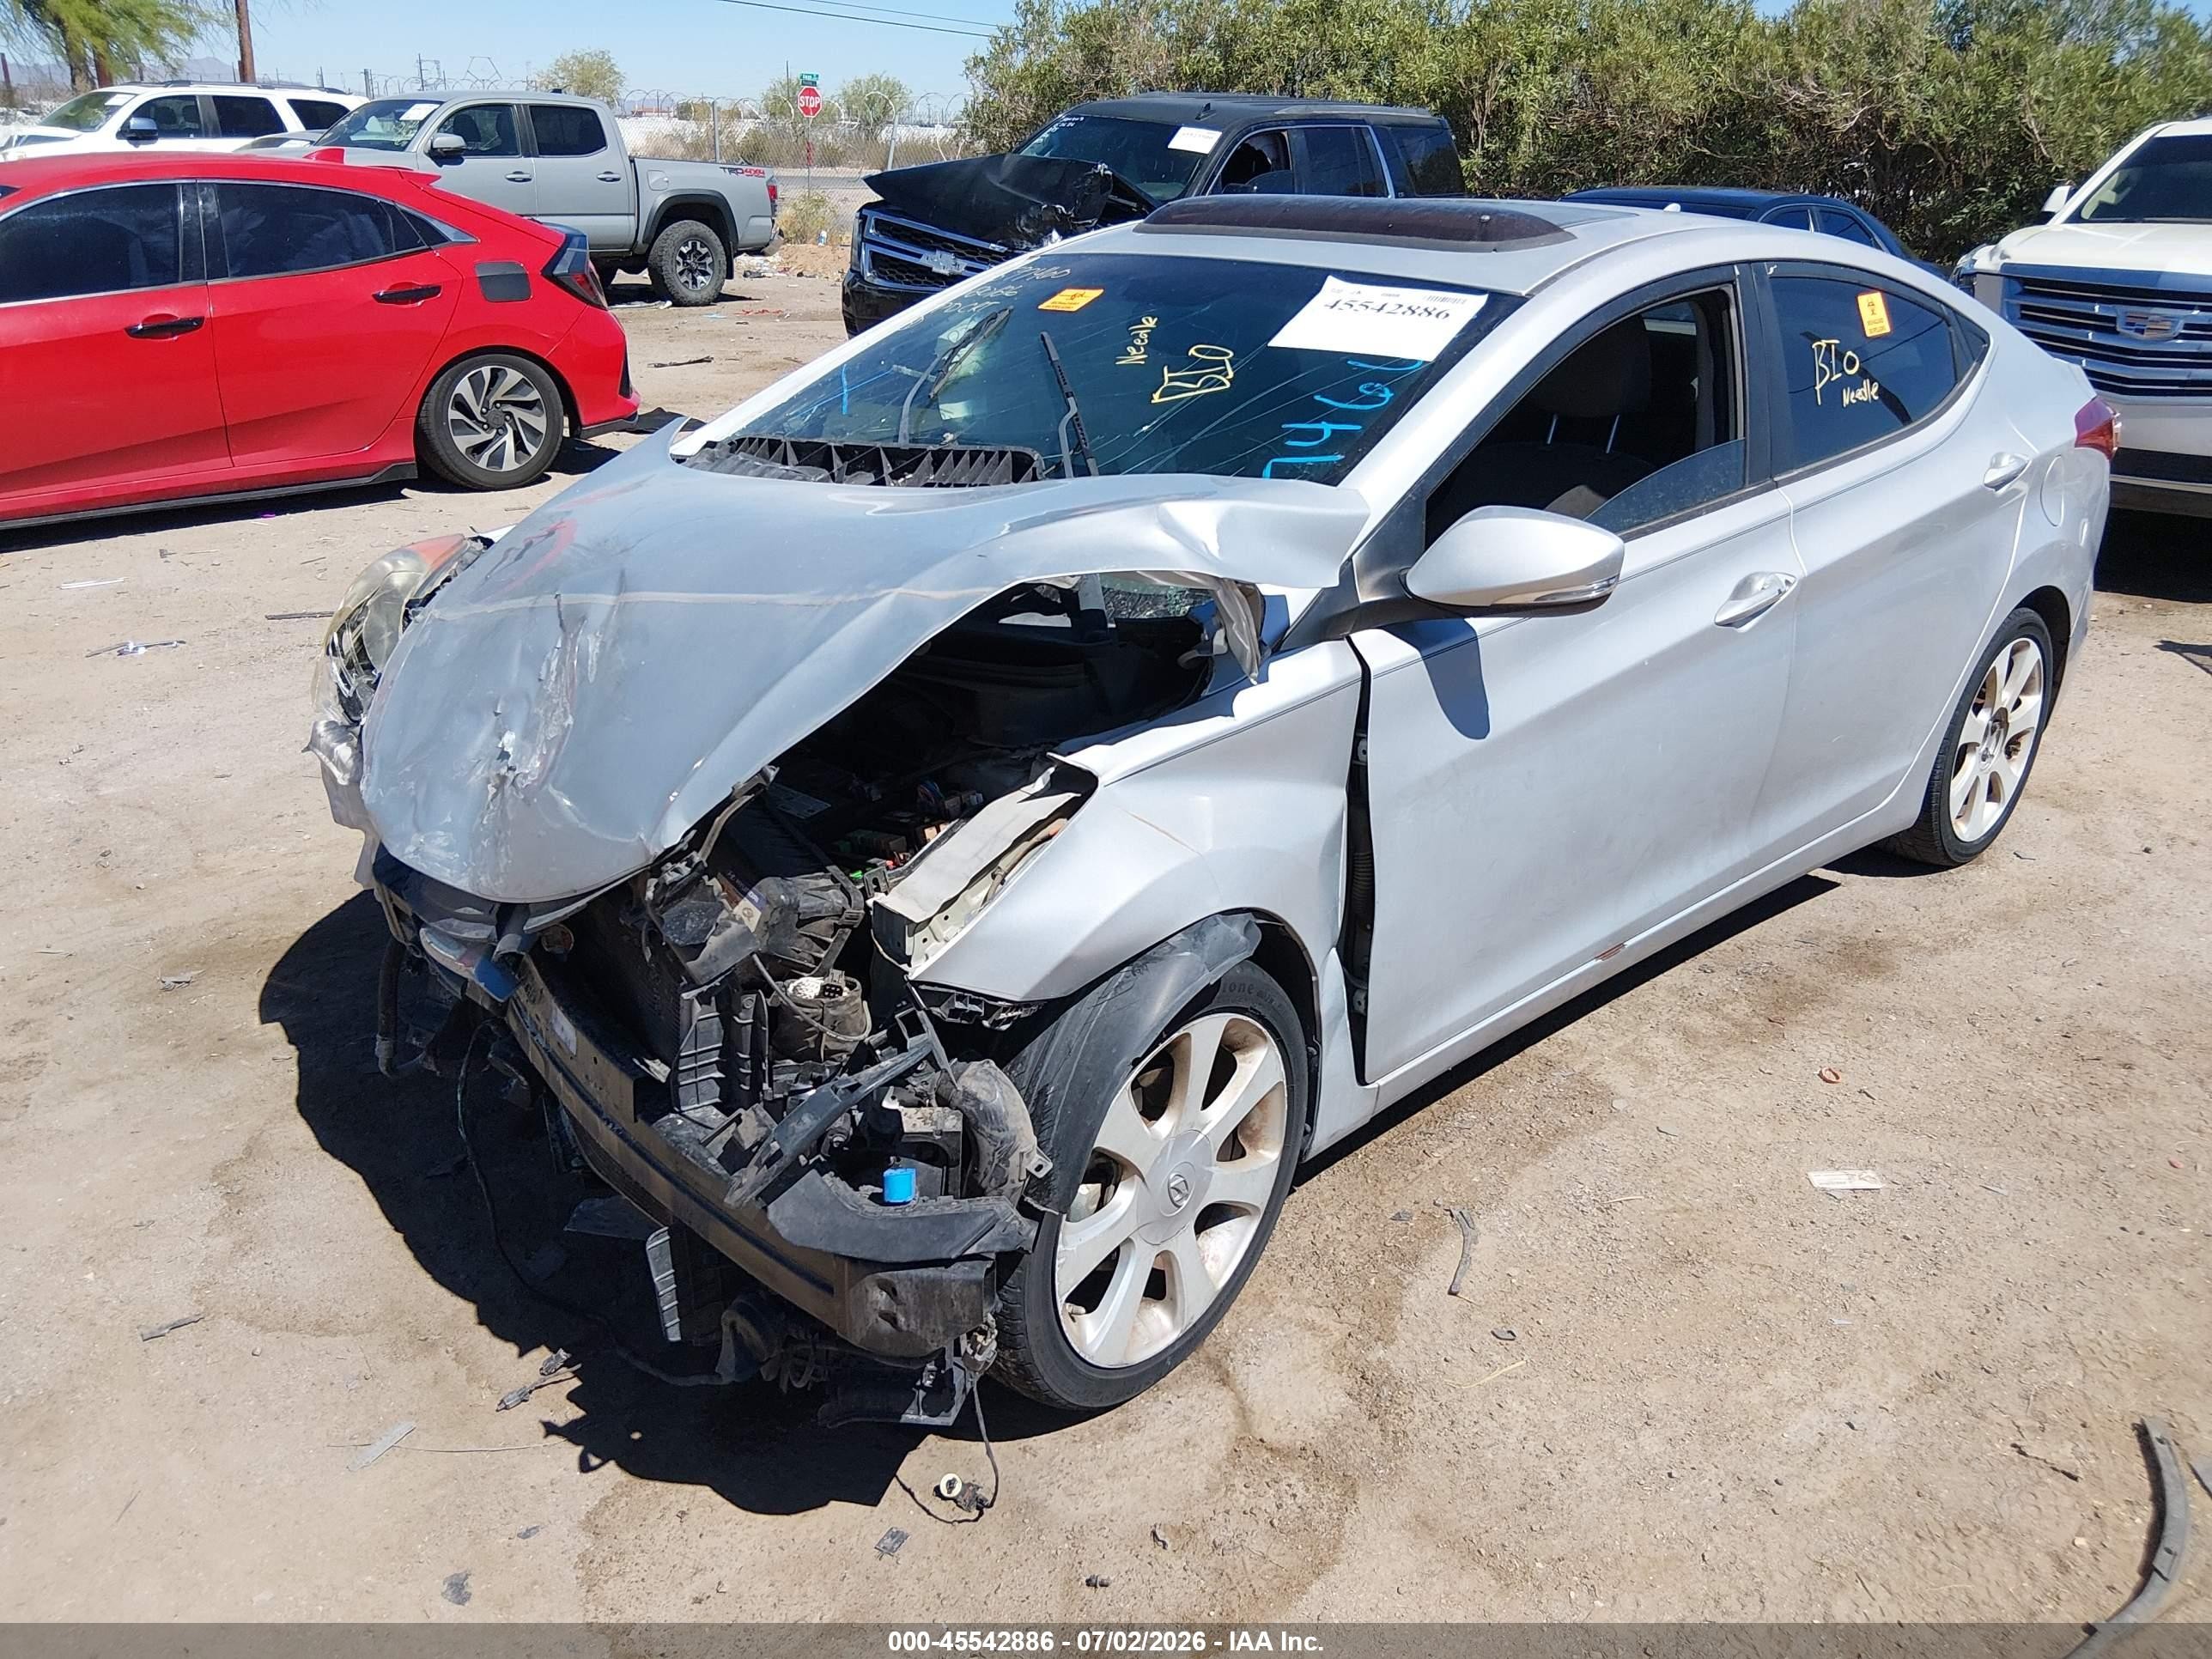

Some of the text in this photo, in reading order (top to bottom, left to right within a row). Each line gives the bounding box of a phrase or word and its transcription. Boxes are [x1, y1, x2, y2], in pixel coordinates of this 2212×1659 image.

[799, 95, 821, 108] STOP
[1324, 299, 1449, 320] 45542886
[1151, 344, 1235, 404] BIO
[1812, 339, 1860, 405] BIO
[1842, 378, 1879, 408] Needle
